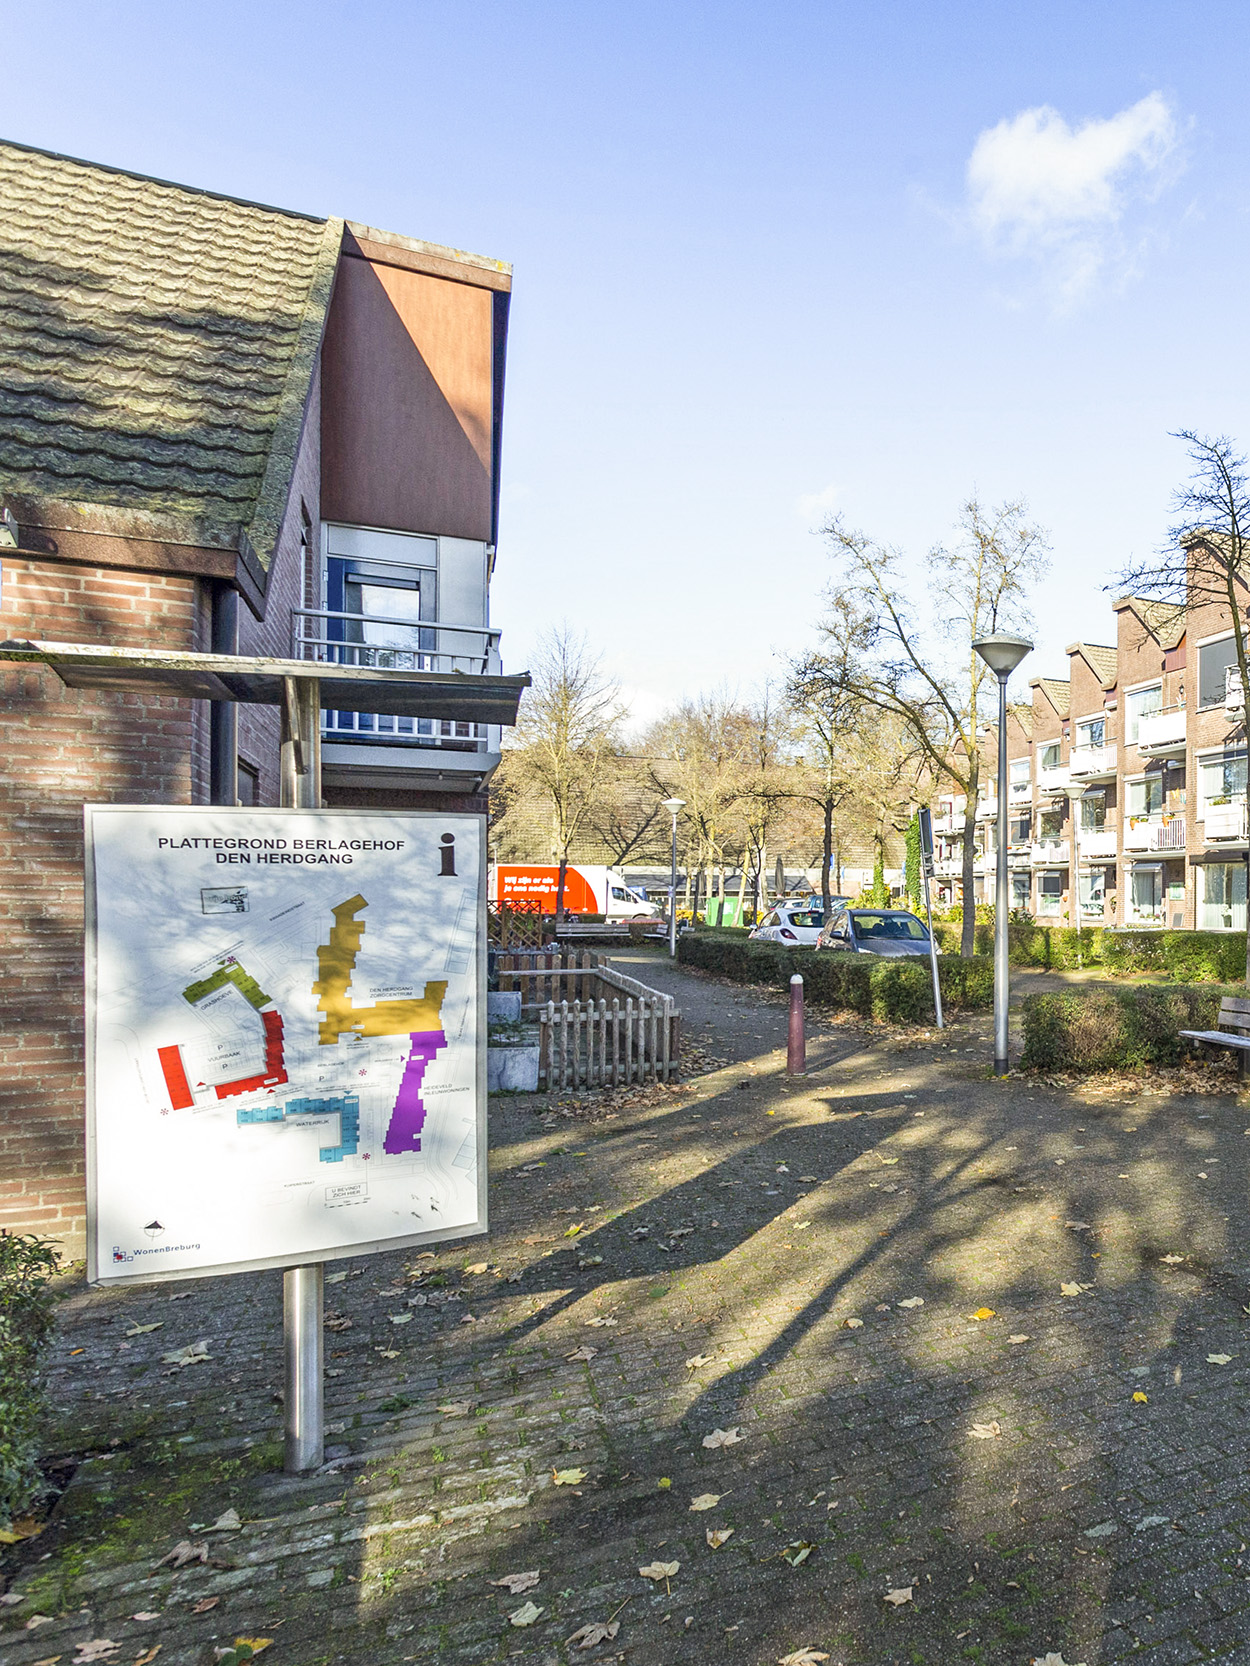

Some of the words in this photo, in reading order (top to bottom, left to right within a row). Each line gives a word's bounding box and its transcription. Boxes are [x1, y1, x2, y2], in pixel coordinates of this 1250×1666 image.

[158, 837, 288, 850] PLATTEGROND
[292, 839, 406, 851] BERLAGEHOF
[215, 852, 252, 864] DEN
[256, 853, 354, 865] HERDGANG
[504, 876, 517, 885] Wij
[518, 876, 532, 885] zijn
[542, 876, 554, 884] als
[503, 884, 512, 893] je
[528, 884, 550, 893] nodig
[200, 988, 234, 1011] GRASHOEVE
[132, 1243, 201, 1256] WonenBreburg
